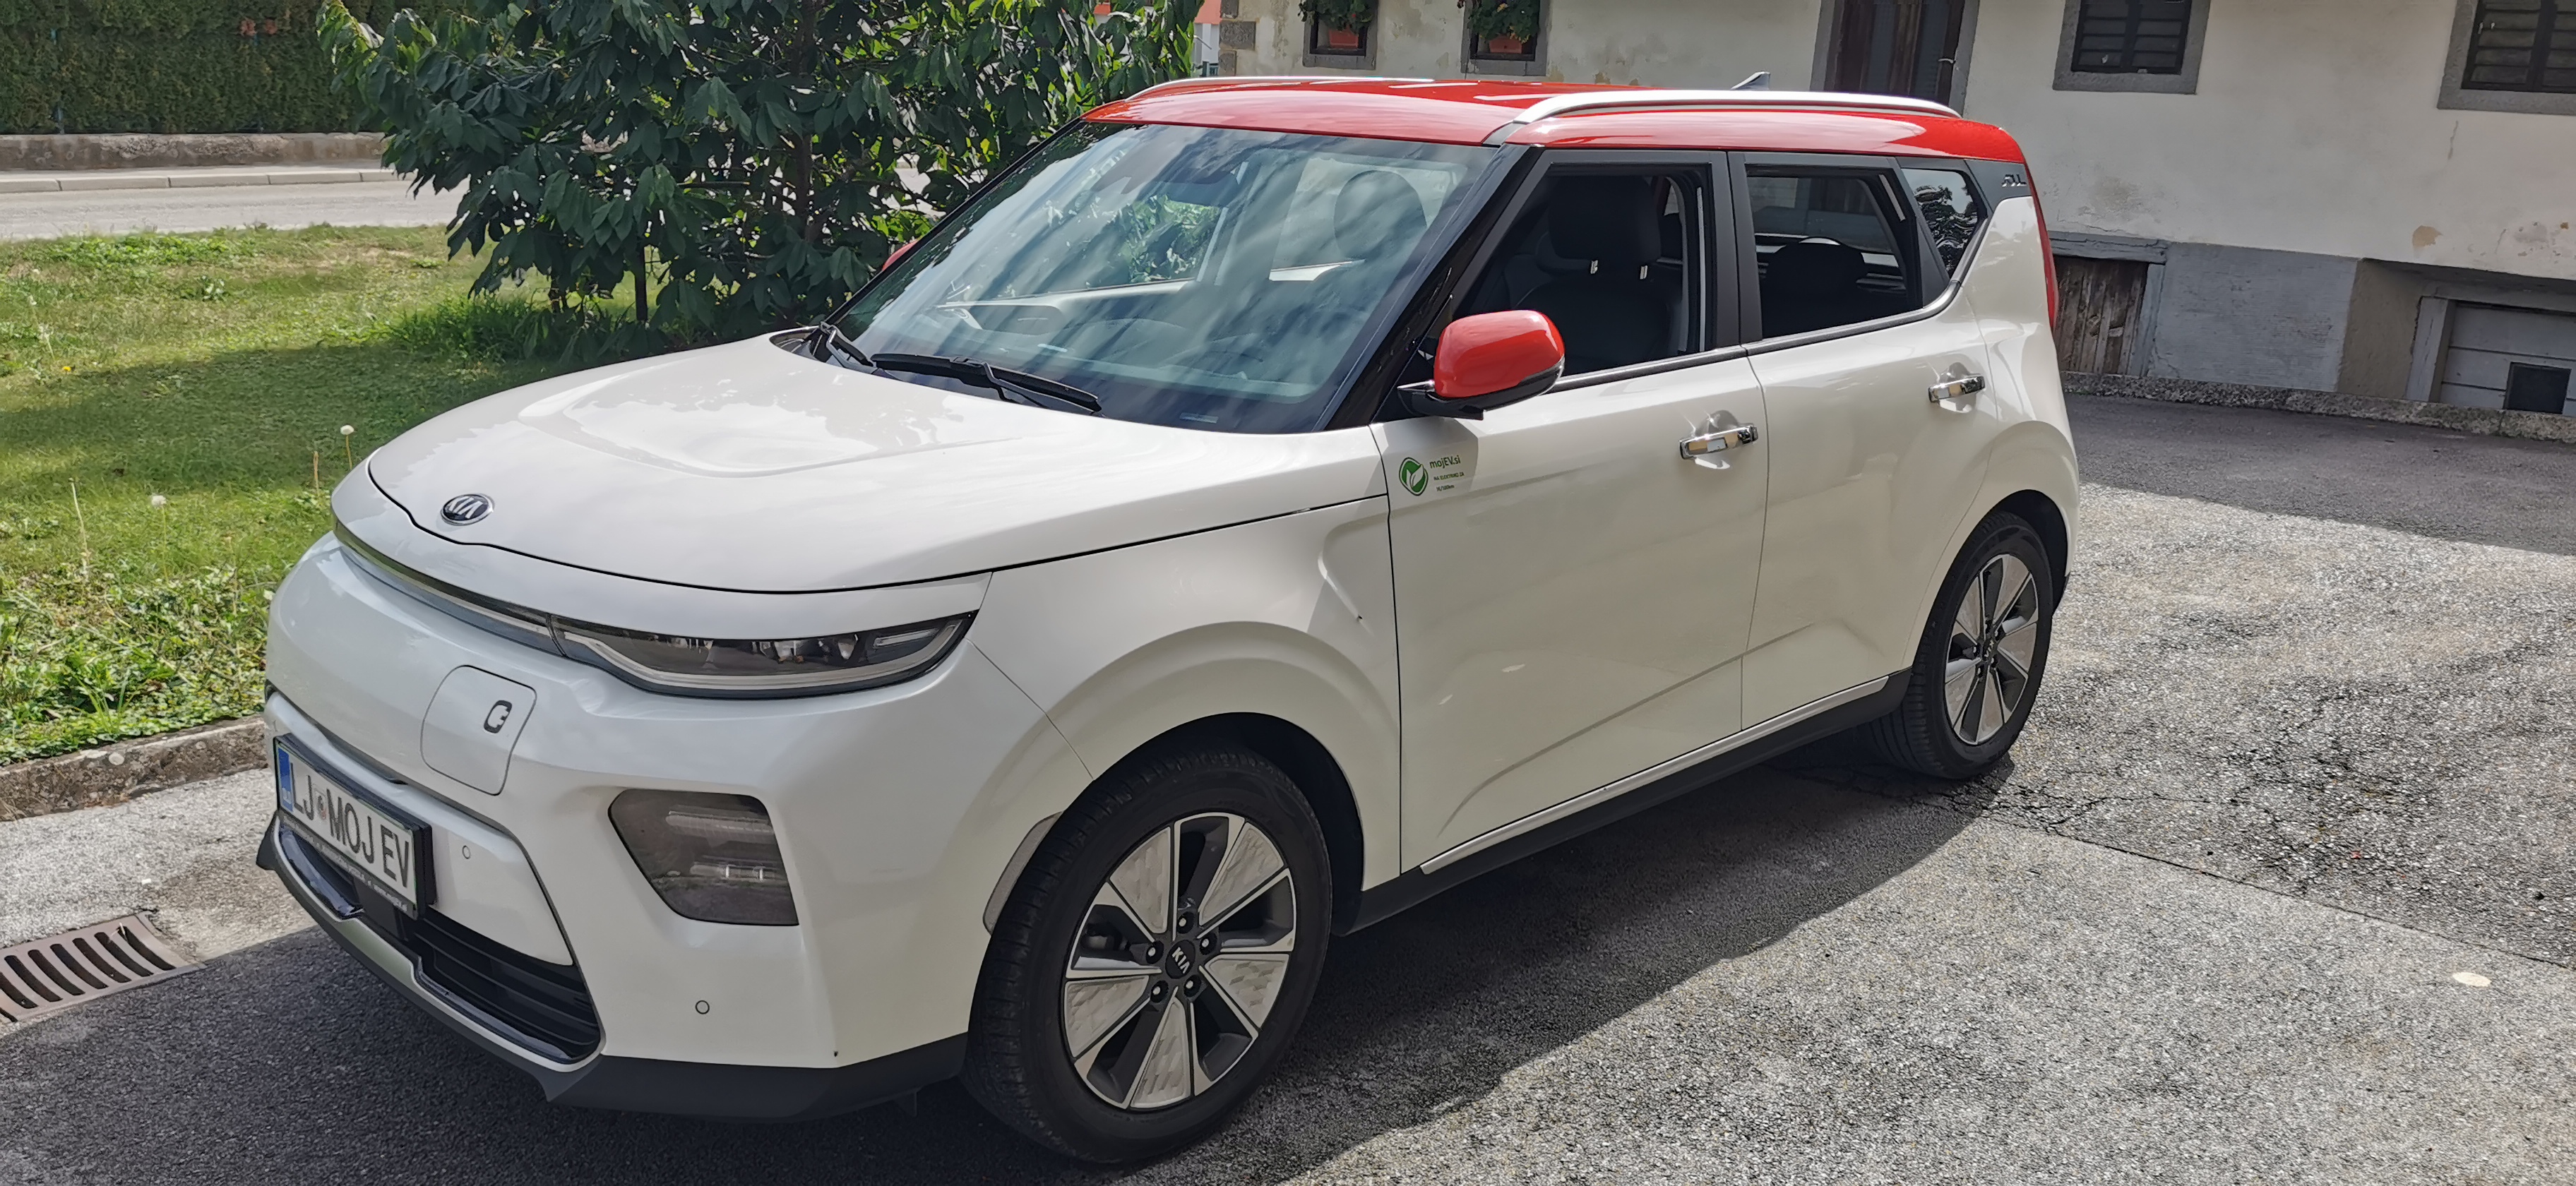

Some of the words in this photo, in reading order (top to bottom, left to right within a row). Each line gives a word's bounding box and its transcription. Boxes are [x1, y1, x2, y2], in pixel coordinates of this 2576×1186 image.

[1429, 455, 1461, 469] mojEV.si
[447, 496, 484, 519] KIA
[290, 762, 314, 821] LJ
[326, 788, 374, 864] MOJ
[381, 824, 410, 888] EV
[1172, 947, 1190, 974] KIA
